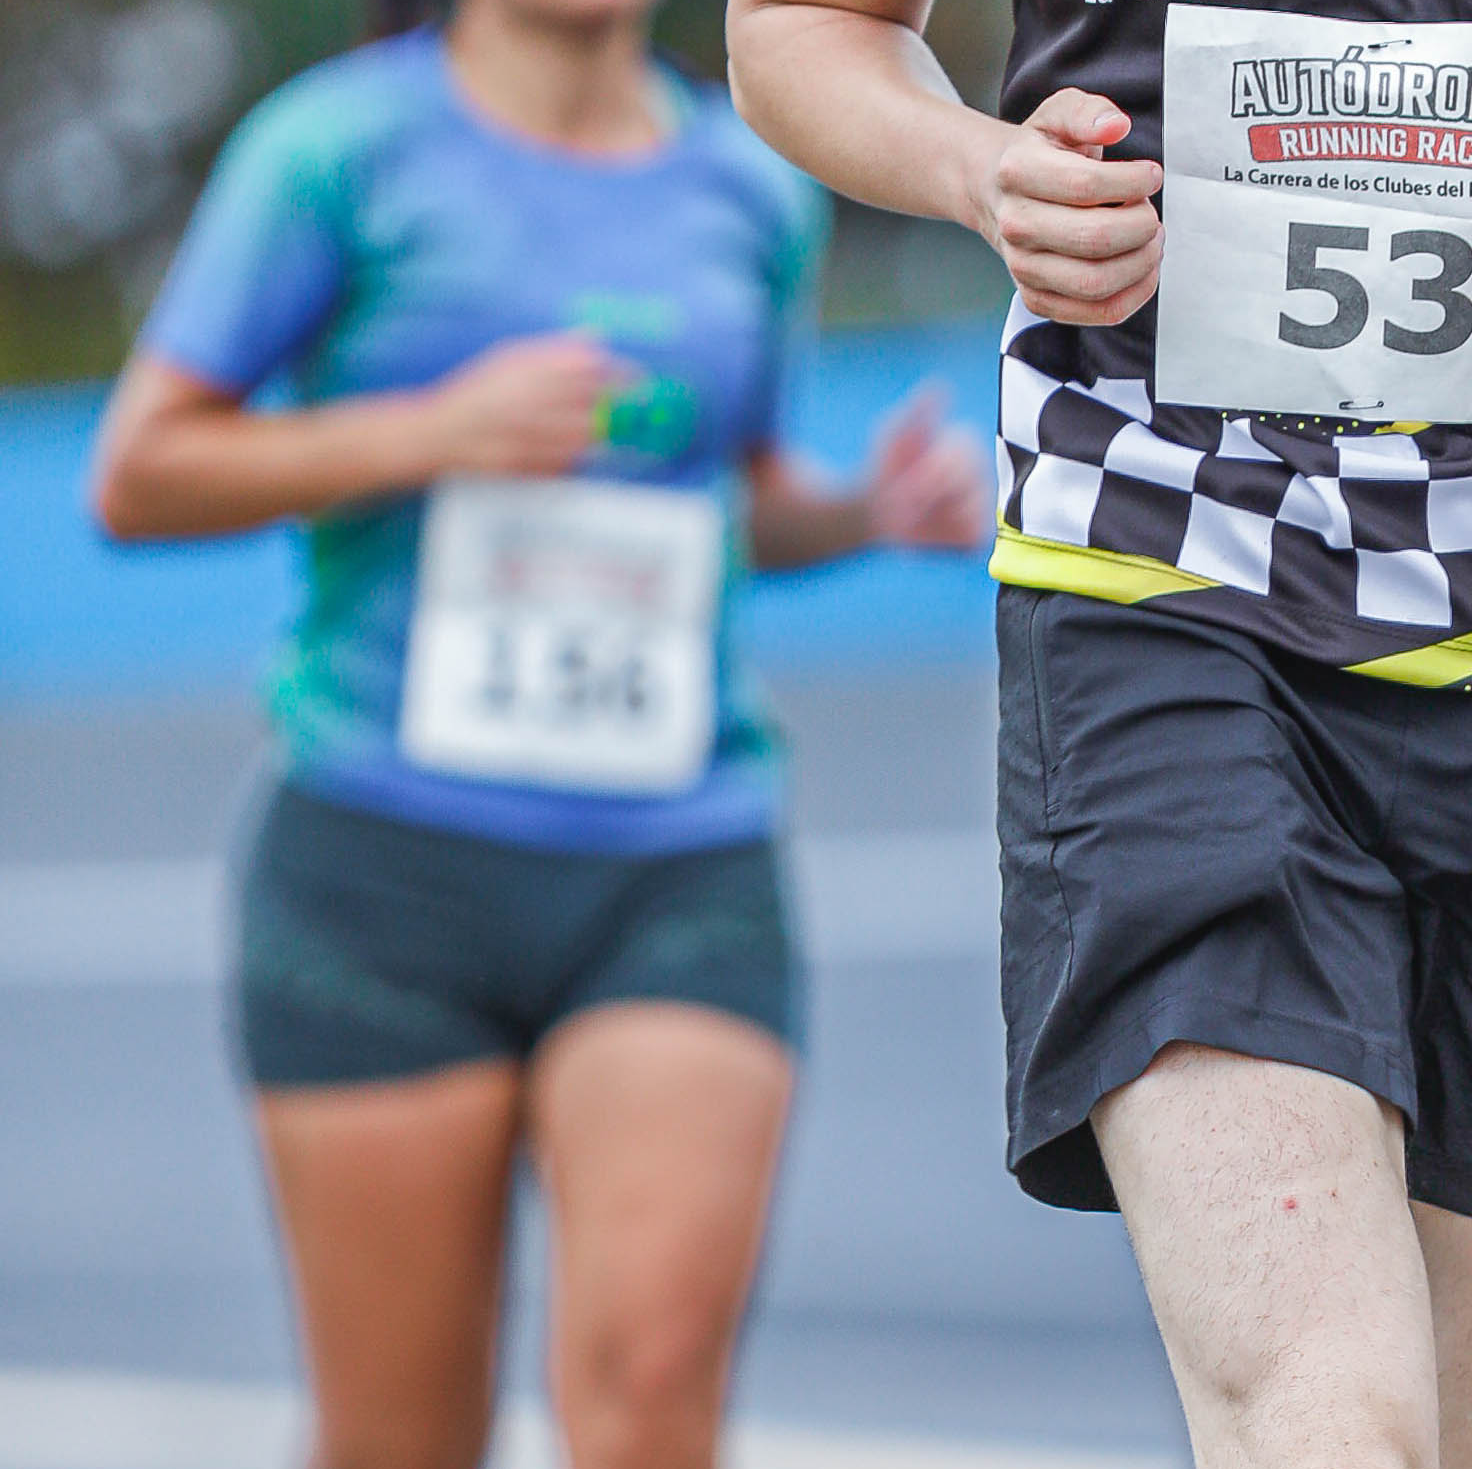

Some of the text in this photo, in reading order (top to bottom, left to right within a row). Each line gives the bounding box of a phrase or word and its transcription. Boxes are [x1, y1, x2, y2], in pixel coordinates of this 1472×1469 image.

[1278, 126, 1408, 159] RUNNING
[1224, 165, 1244, 183] La
[1248, 168, 1313, 188] Carrera
[1317, 172, 1340, 189] de
[1344, 174, 1370, 192] los
[1373, 176, 1433, 196] Clubes
[1437, 180, 1464, 198] del
